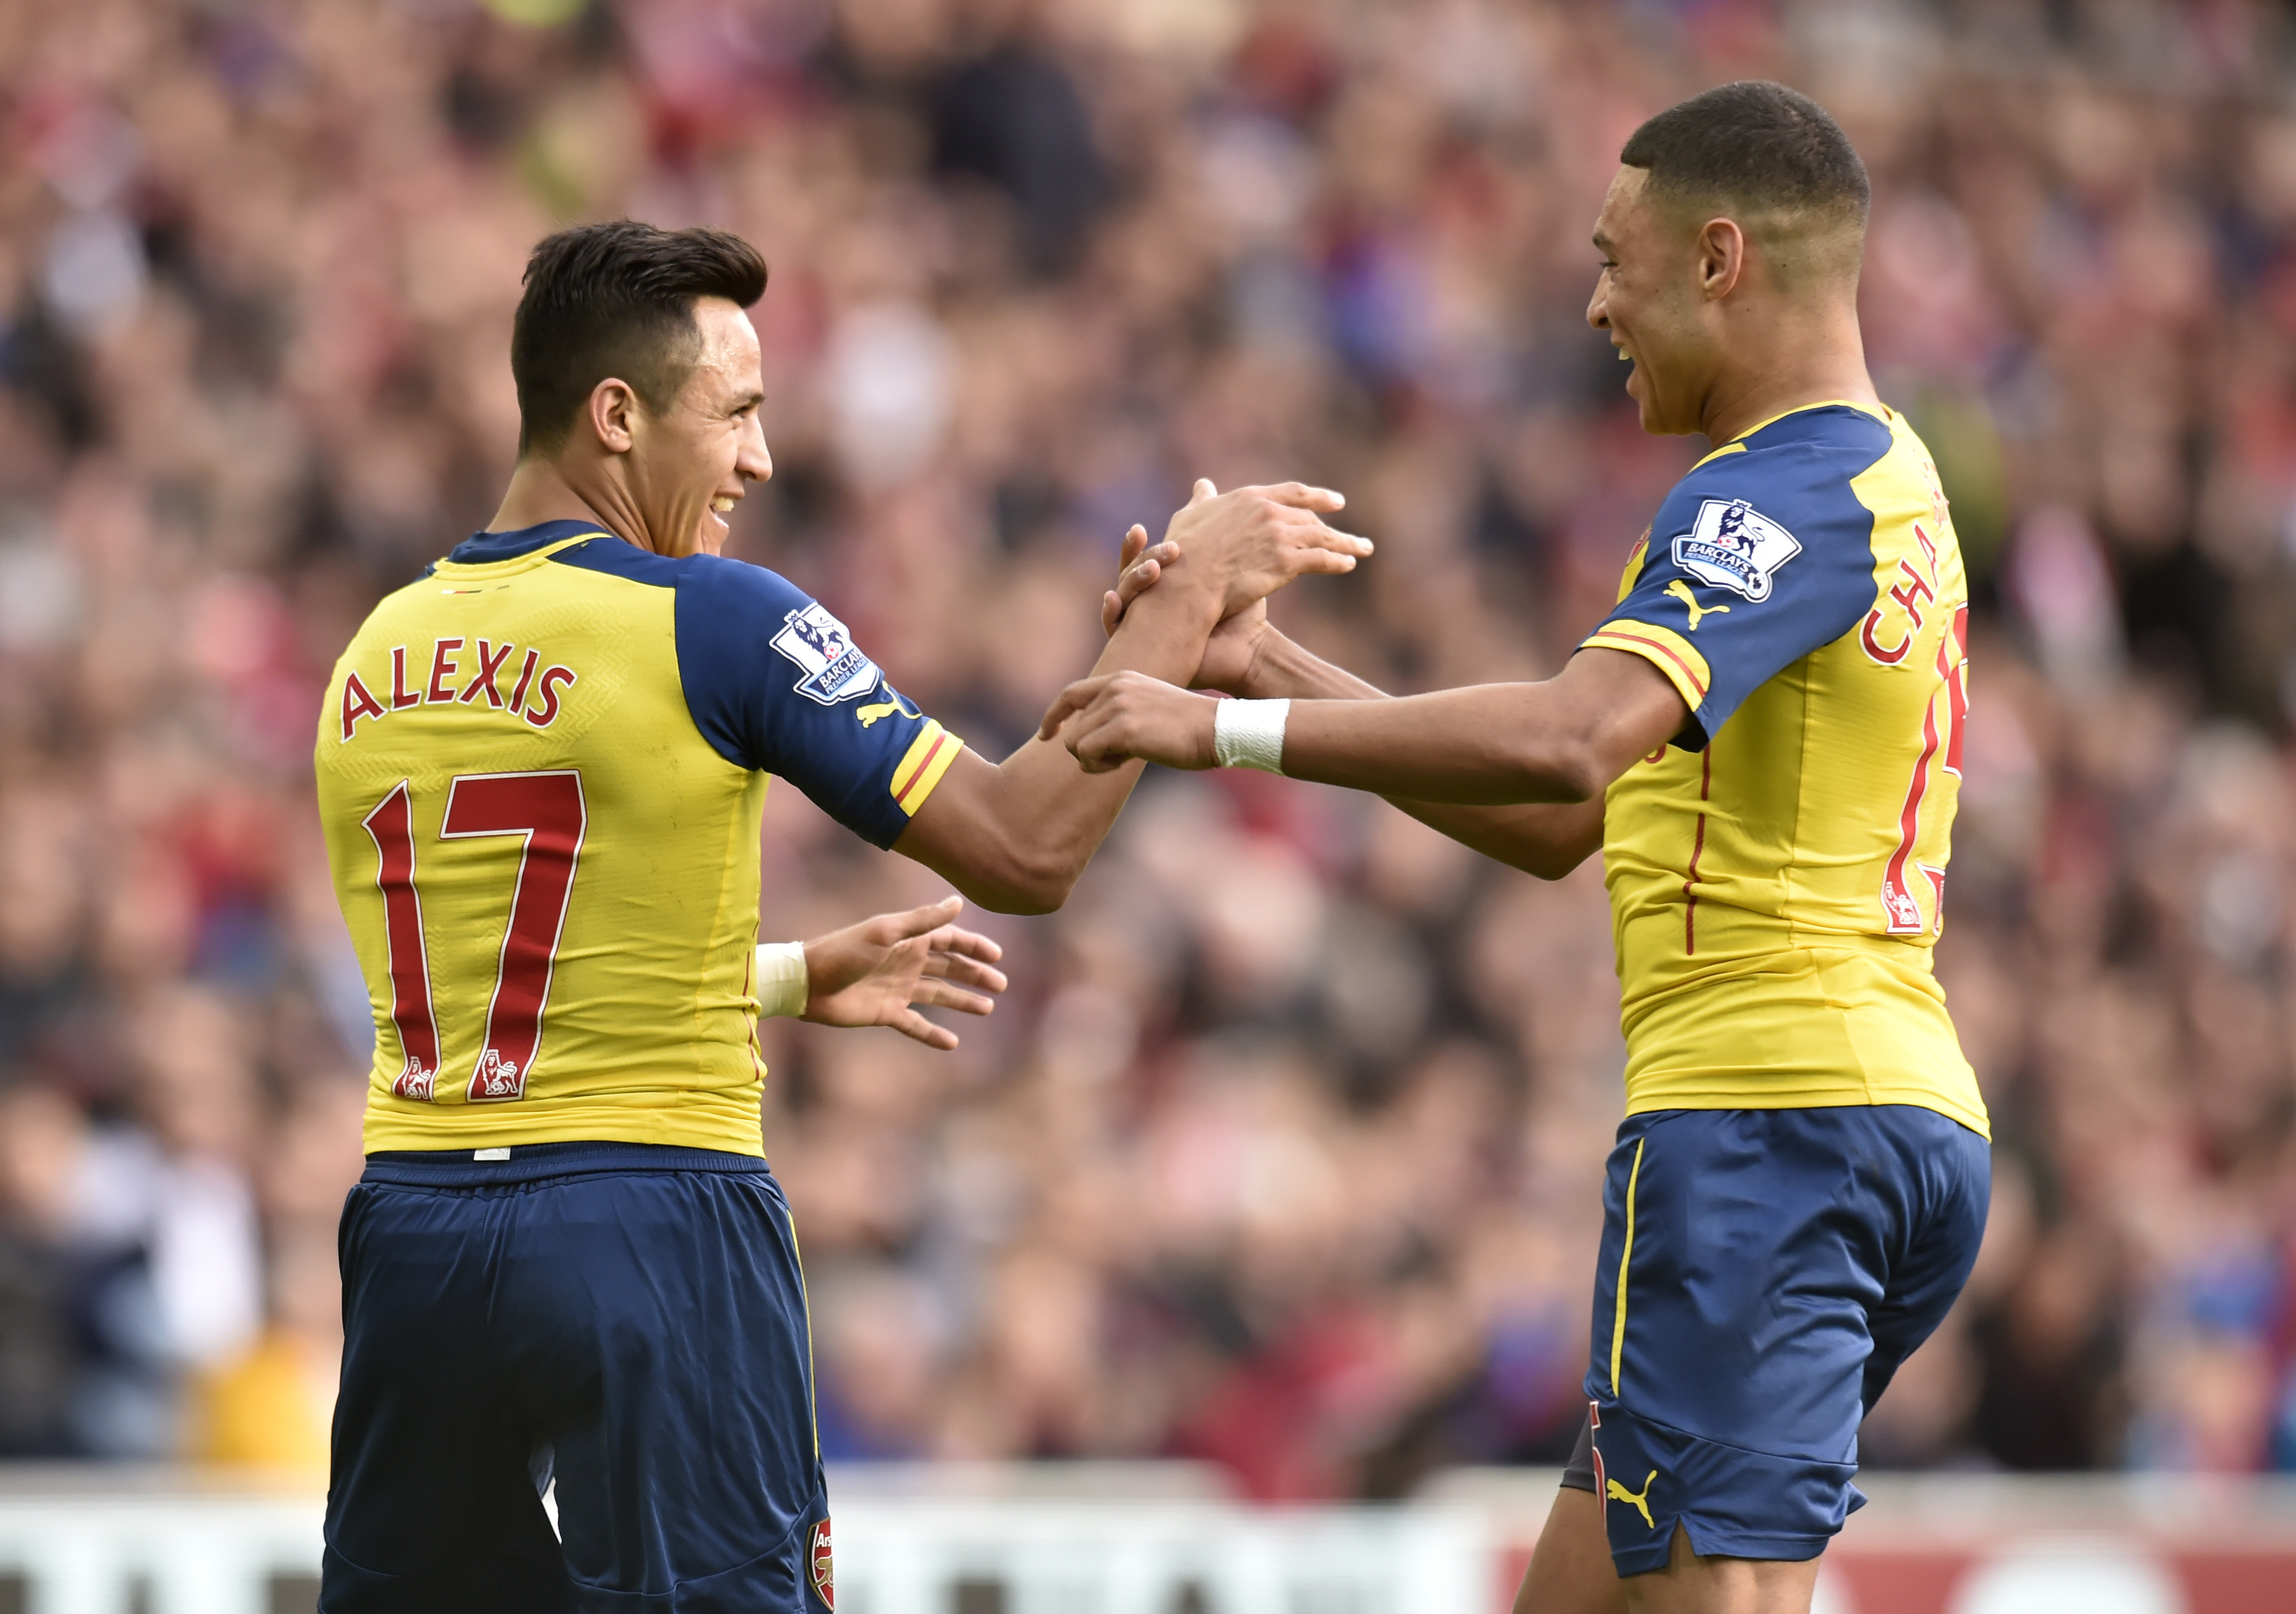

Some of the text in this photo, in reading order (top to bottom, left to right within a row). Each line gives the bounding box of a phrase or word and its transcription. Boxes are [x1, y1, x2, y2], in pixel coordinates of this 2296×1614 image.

[1687, 543, 1751, 572] BARCLAYS
[340, 636, 578, 745] ALEXIS
[825, 671, 853, 694] PREMIER
[361, 768, 588, 1104] 17
[816, 1533, 832, 1547] Ars
